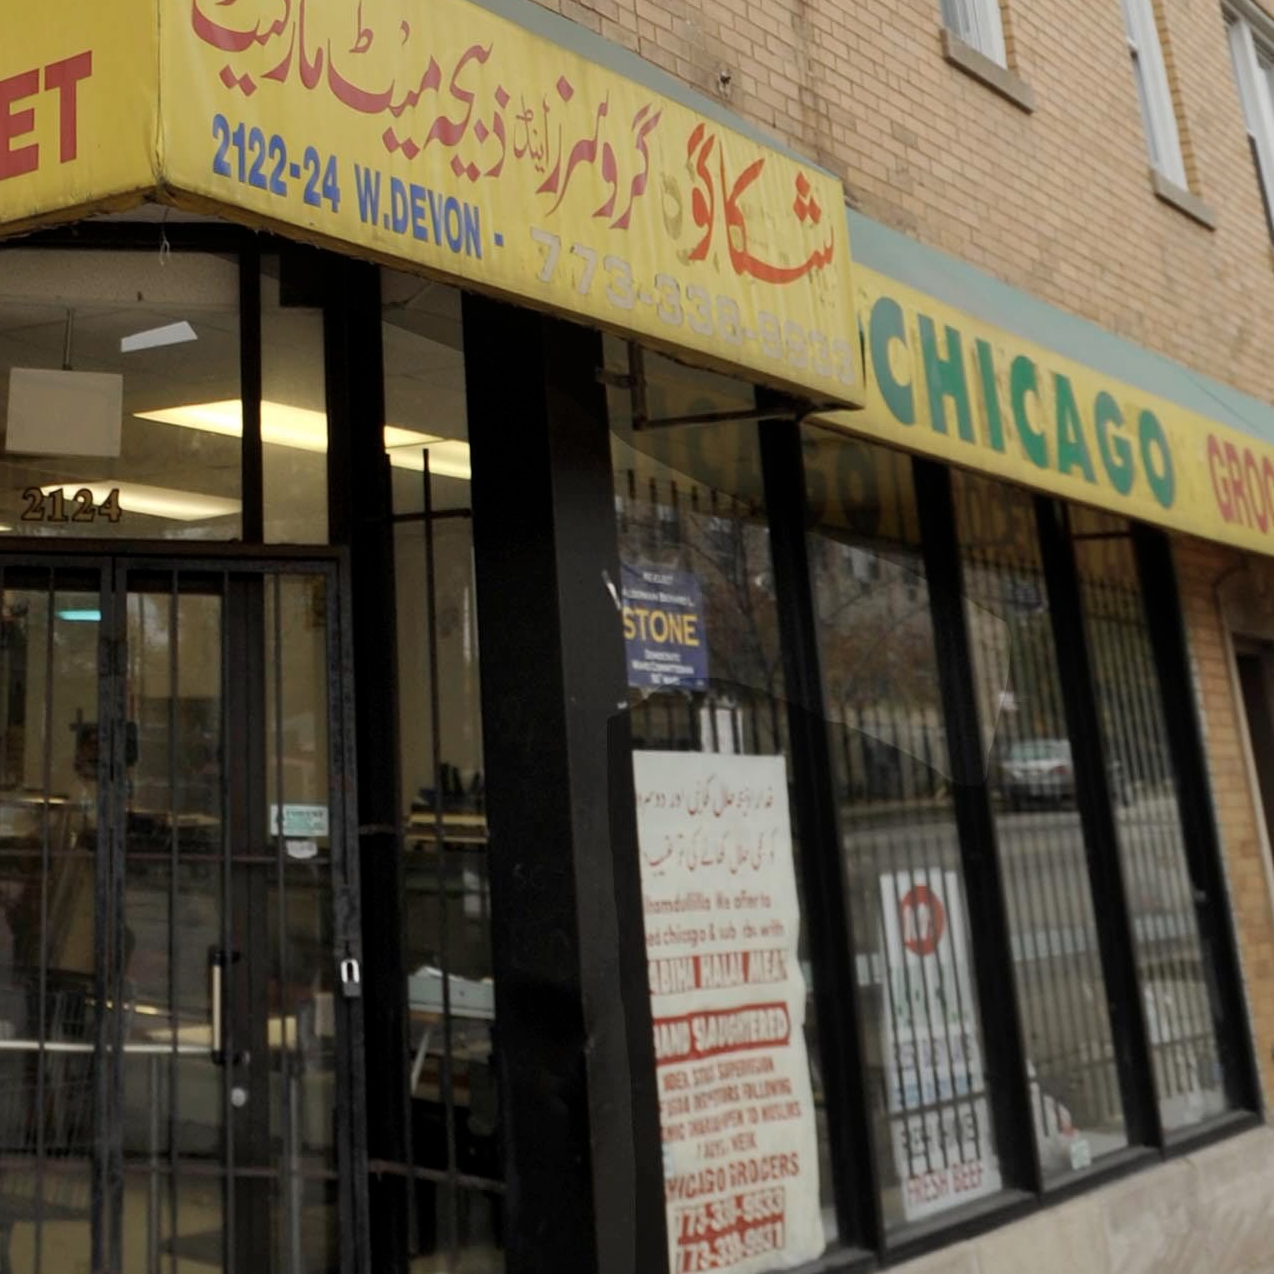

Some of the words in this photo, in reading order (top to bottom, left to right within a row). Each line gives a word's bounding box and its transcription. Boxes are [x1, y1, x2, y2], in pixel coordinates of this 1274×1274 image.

[212, 113, 341, 214] 2122-24
[869, 296, 1175, 511] CHICAGO
[20, 486, 123, 524] 2124
[622, 604, 701, 647] STONE
[728, 1150, 800, 1187] GROCERS
